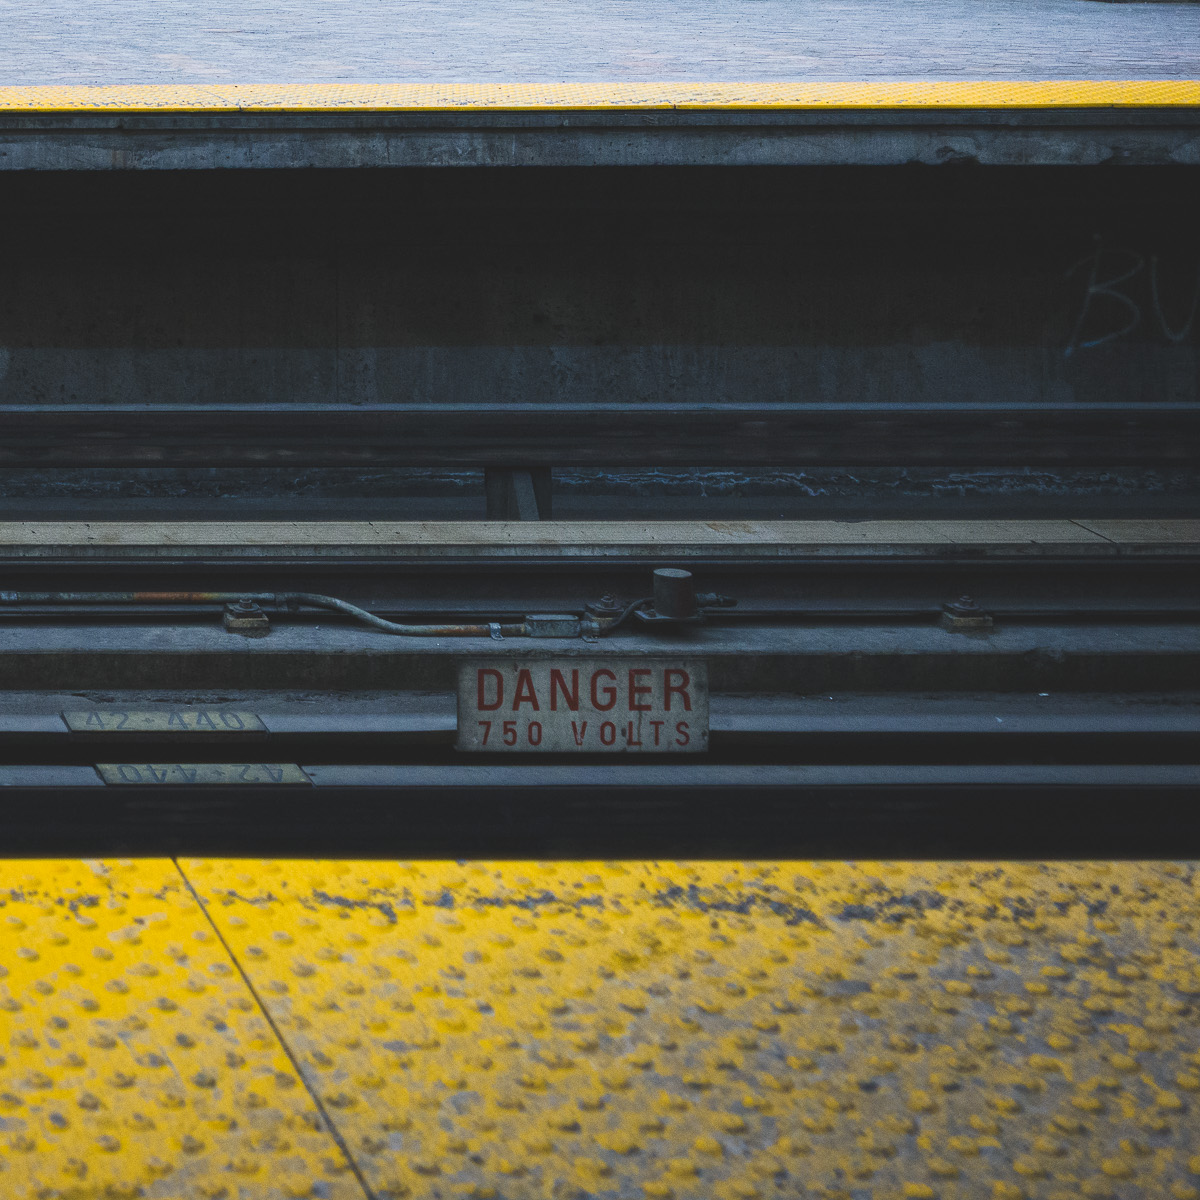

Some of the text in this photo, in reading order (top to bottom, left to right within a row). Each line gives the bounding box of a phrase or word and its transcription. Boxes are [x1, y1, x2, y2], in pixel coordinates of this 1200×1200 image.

[477, 668, 693, 712] DANGER
[478, 720, 691, 747] 750 VOLTS
